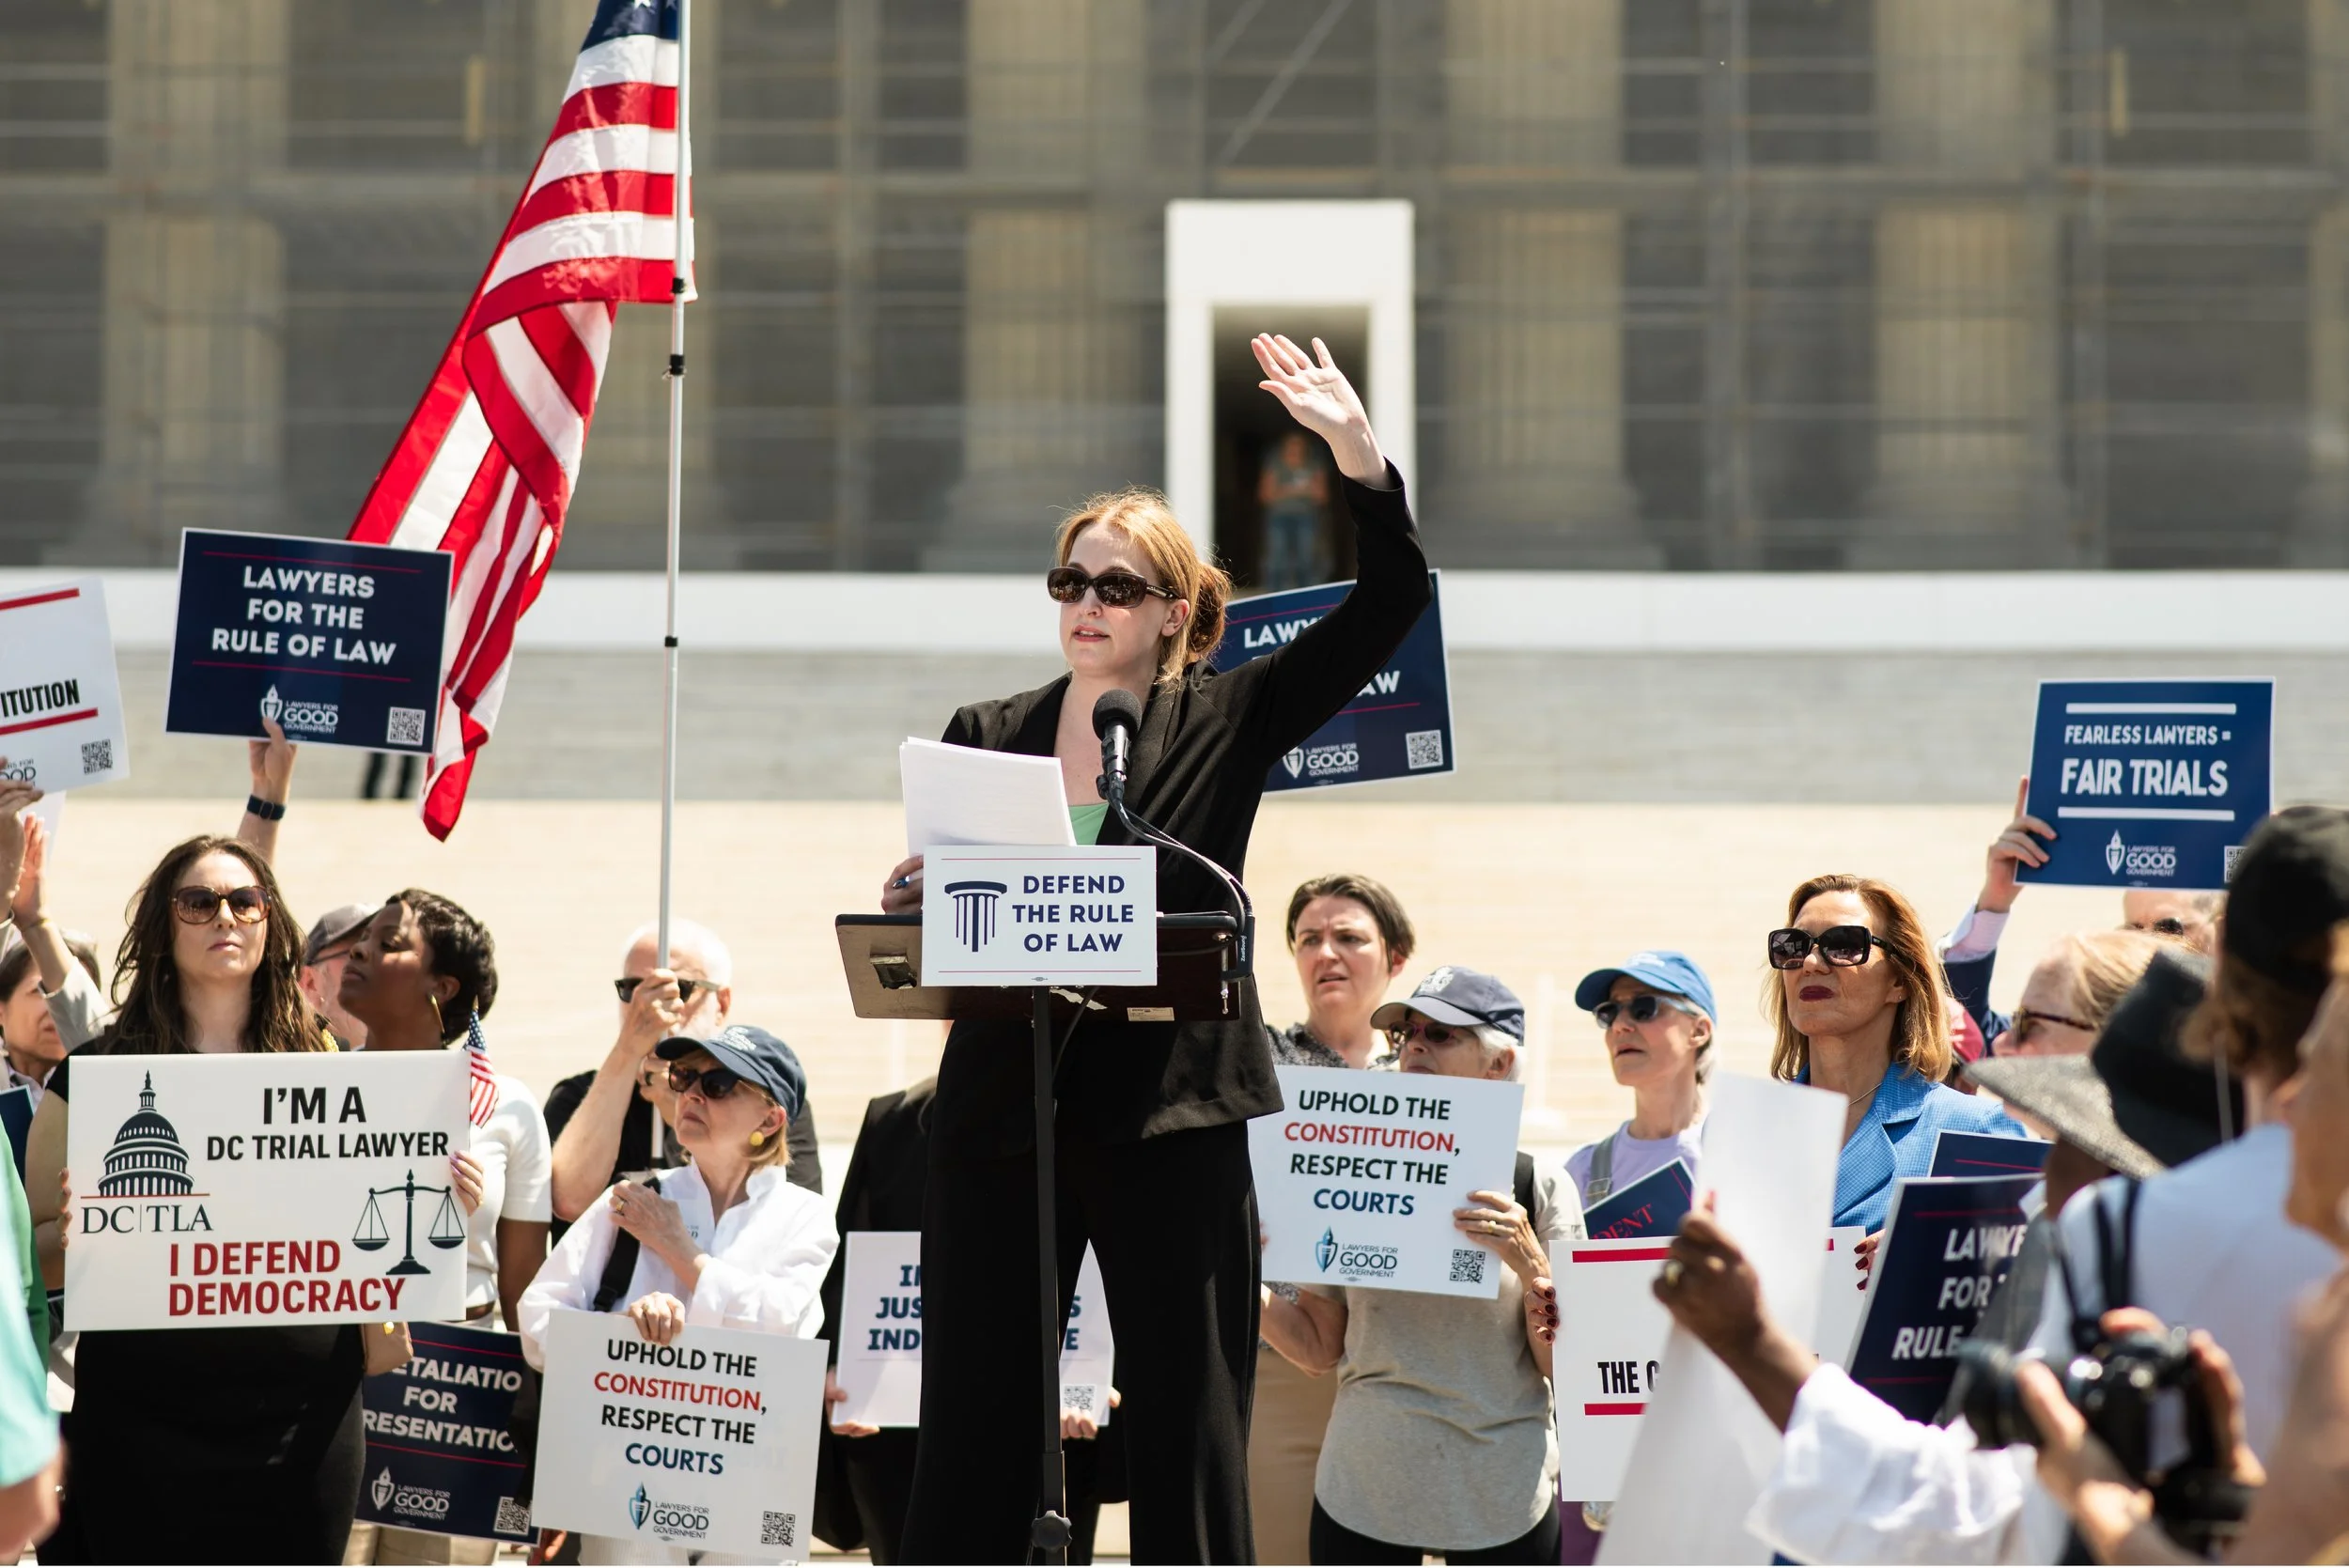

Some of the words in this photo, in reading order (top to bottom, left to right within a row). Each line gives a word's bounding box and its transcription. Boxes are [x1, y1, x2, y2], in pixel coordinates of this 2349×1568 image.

[243, 566, 375, 598] LAWYERS
[248, 598, 303, 626] FOR
[312, 603, 365, 629] THE
[211, 629, 279, 655] RULE
[288, 633, 325, 658] OF
[334, 637, 397, 665] LAW
[284, 707, 338, 726] GOOD
[286, 701, 320, 710] LAWYERS
[322, 704, 338, 712] FOR
[284, 722, 336, 734] GOVERNMENT
[2064, 724, 2141, 744] FEARLESS
[2144, 724, 2217, 745] LAWYERS
[1306, 744, 1340, 755] LAWYERS
[1342, 742, 1357, 751] FOR
[1306, 751, 1360, 768] GOOD
[1309, 764, 1359, 776] GOVERNMENT
[2061, 758, 2123, 795] FAIR
[2129, 759, 2229, 797] TRIALS
[2126, 852, 2176, 869] GOOD
[2126, 867, 2174, 877] GOVERNMENT
[1023, 876, 1125, 893] DEFEND
[1012, 905, 1061, 923] THE
[1070, 905, 1134, 923] RULE
[1023, 933, 1058, 952] OF
[1067, 933, 1123, 952] LAW
[263, 1086, 327, 1125] I'M
[338, 1086, 366, 1123] A
[1299, 1090, 1399, 1116] UPHOLD
[1406, 1096, 1451, 1121] THE
[207, 1135, 244, 1161] DC
[252, 1133, 331, 1159] TRIAL
[338, 1131, 449, 1158] LAWYER
[1284, 1122, 1460, 1157] CONSTITUTION,
[1290, 1154, 1397, 1181] RESPECT
[1403, 1161, 1449, 1185] THE
[1314, 1188, 1415, 1216] COURTS
[170, 1243, 179, 1277] I
[194, 1239, 341, 1277] DEFEND
[1342, 1243, 1379, 1252] LAWYERS
[1382, 1246, 1398, 1254] FOR
[1340, 1251, 1397, 1269] GOOD
[1339, 1266, 1394, 1278] GOVERNMENT
[168, 1277, 406, 1316] DEMOCRACY
[1937, 1275, 1992, 1311] FOR
[607, 1338, 706, 1371] UPHOLD
[712, 1351, 757, 1377] THE
[1597, 1361, 1640, 1394] THE
[403, 1385, 458, 1414] FOR
[594, 1371, 767, 1415] CONSTITUTION,
[601, 1405, 706, 1437] RESPECT
[712, 1419, 755, 1444] THE
[625, 1443, 724, 1475] COURTS
[397, 1484, 433, 1496] LAWYERS
[393, 1506, 446, 1520] GOVERNMENT
[395, 1492, 449, 1513] GOOD
[655, 1501, 692, 1512] LAWYERS
[693, 1506, 709, 1514] FOR
[653, 1509, 709, 1530] GOOD
[653, 1525, 707, 1539] GOVERNMENT
